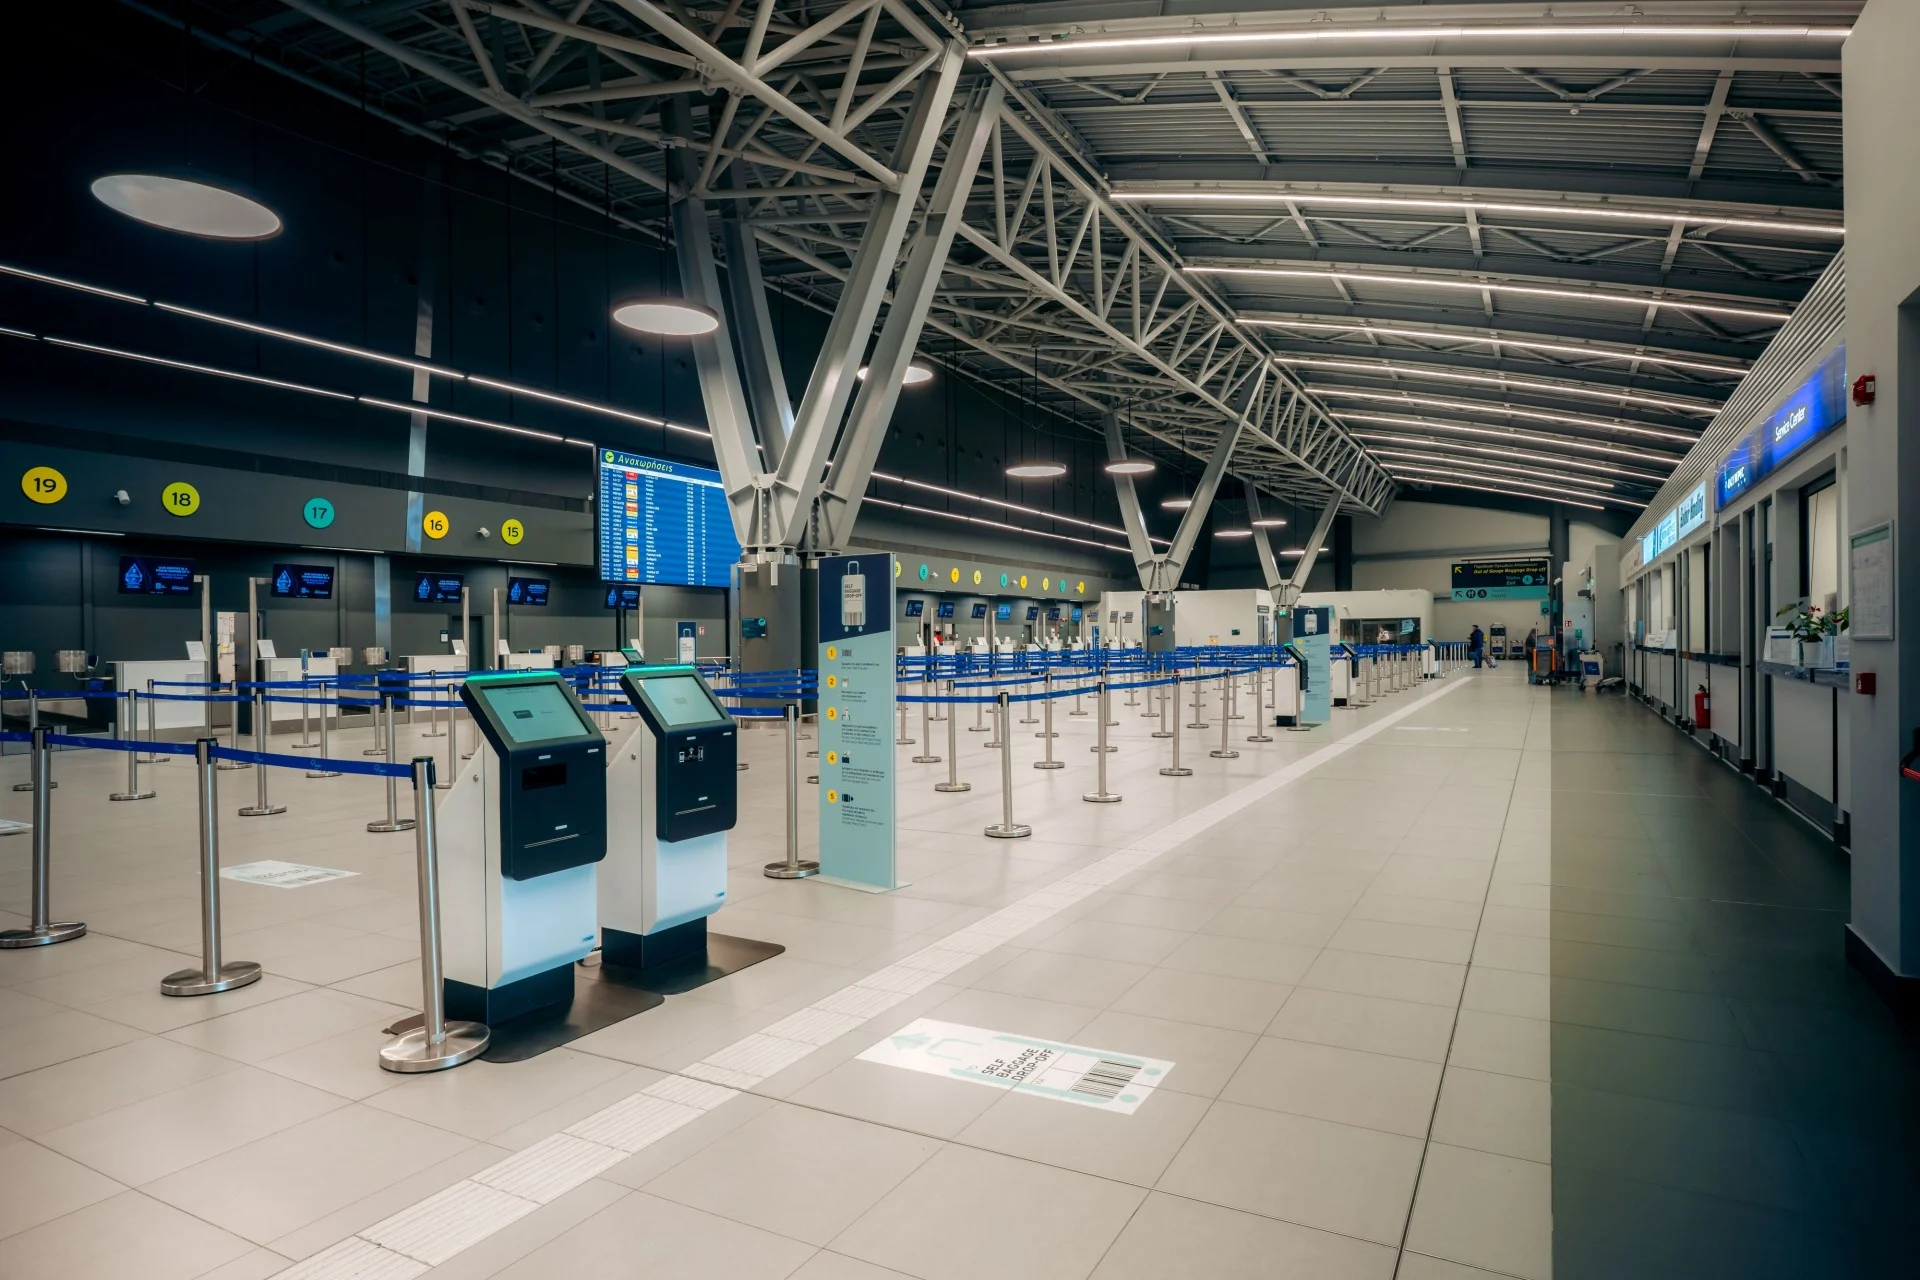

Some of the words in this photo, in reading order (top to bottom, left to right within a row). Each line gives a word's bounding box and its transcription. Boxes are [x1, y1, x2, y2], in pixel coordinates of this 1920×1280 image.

[1775, 419, 1790, 442] Service
[1789, 406, 1806, 429] Center
[617, 454, 673, 473] Αναχωρήσεις
[33, 477, 57, 493] 19
[171, 492, 192, 507] 18
[312, 507, 328, 519] 17
[430, 519, 444, 531] 16
[507, 526, 519, 537] 15
[981, 1058, 1006, 1075] SELF
[996, 1048, 1039, 1078] BAGGAGE
[1011, 1048, 1054, 1082] DROP-OFF
